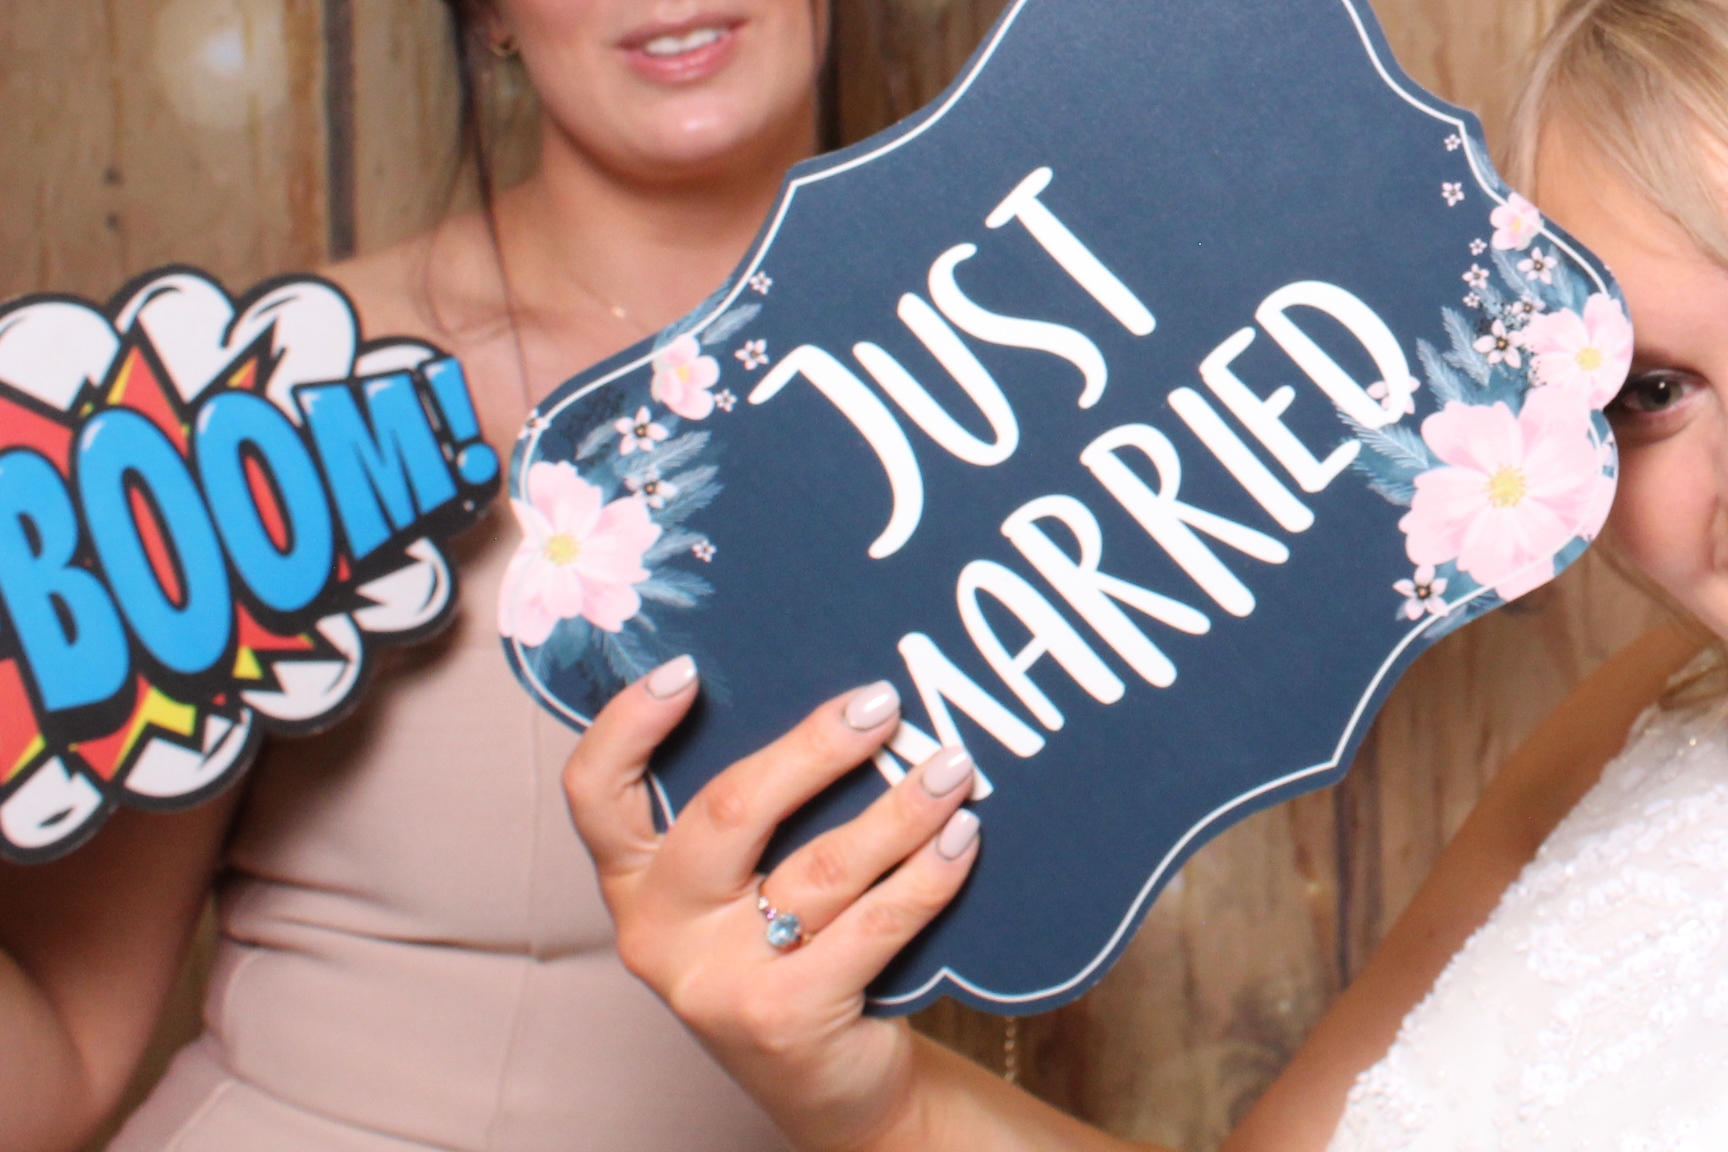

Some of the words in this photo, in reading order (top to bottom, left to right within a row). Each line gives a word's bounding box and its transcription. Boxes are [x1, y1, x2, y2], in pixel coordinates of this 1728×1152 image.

[0, 356, 499, 712] BOOM!
[748, 166, 1157, 560] JUST
[868, 279, 1411, 801] MARRIED
